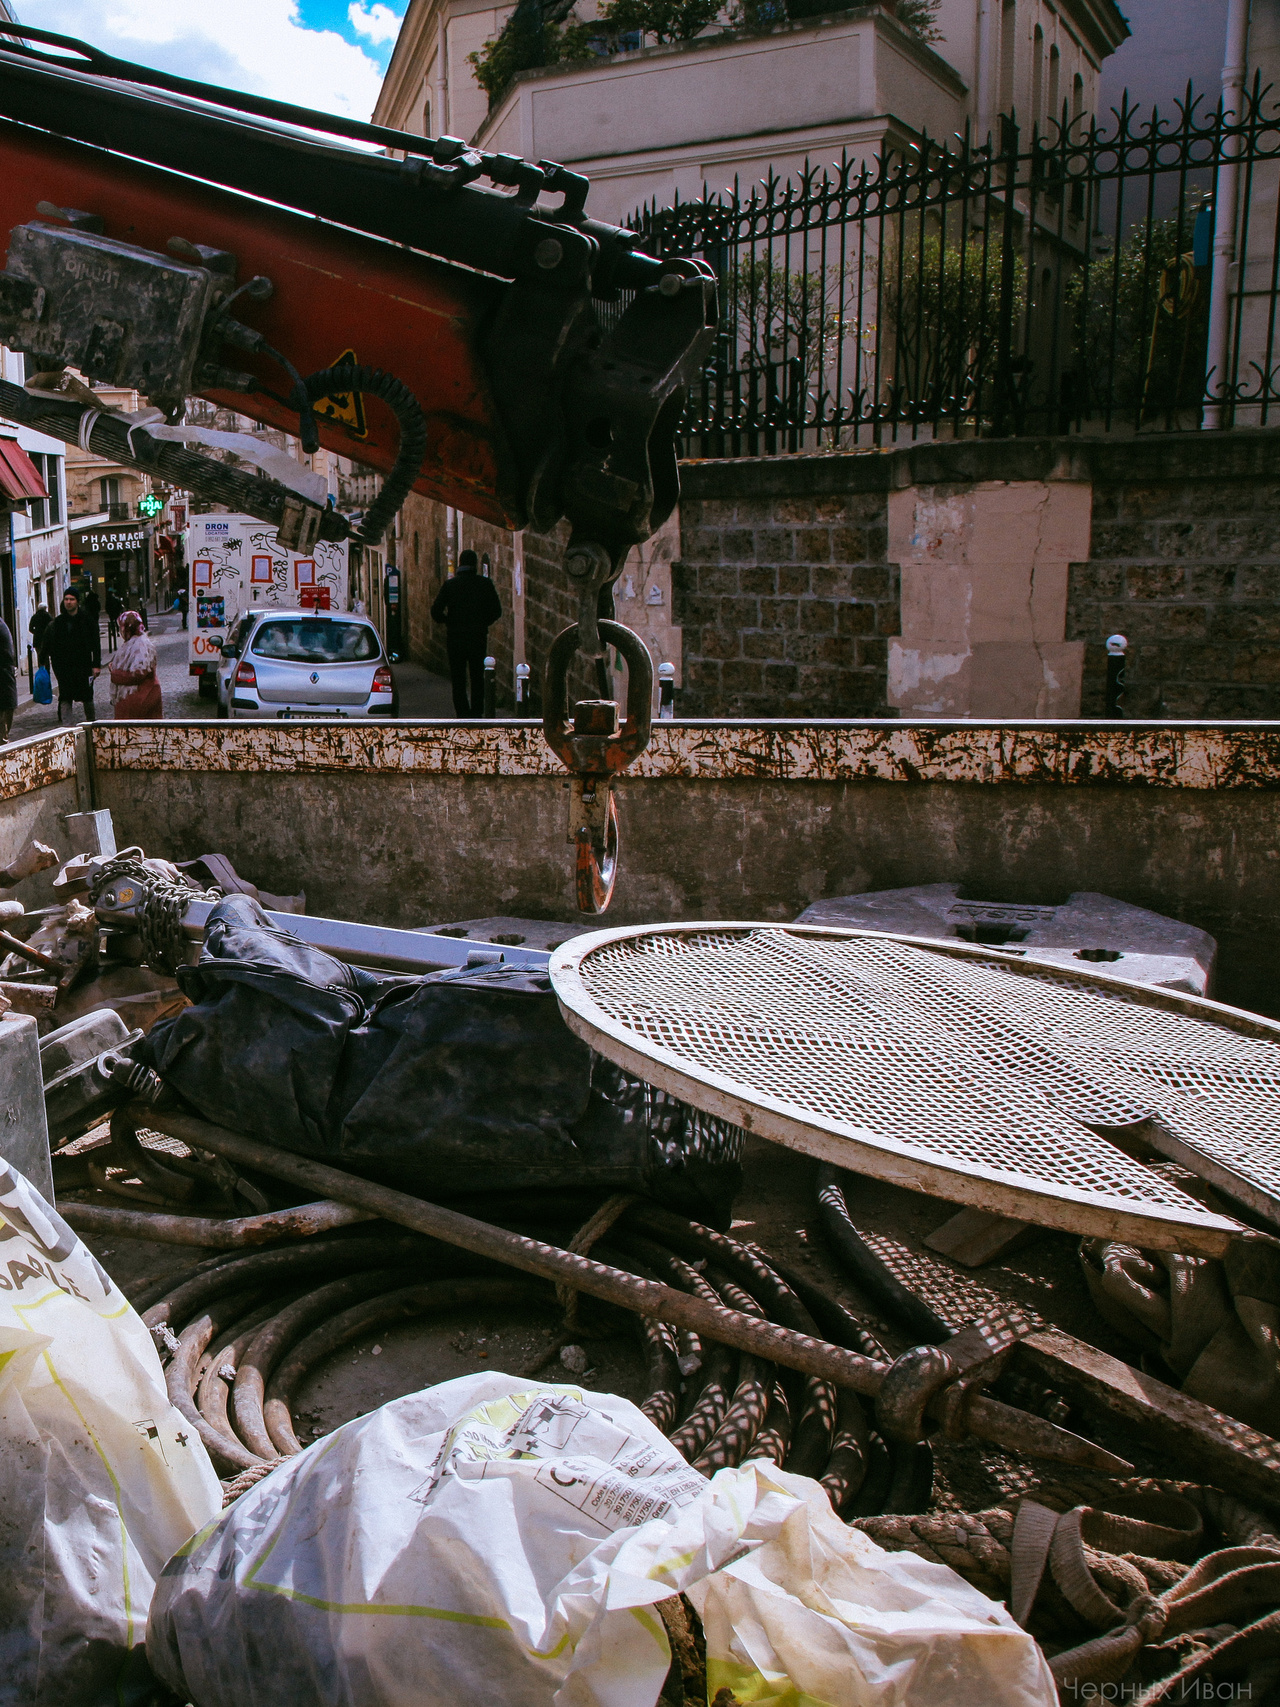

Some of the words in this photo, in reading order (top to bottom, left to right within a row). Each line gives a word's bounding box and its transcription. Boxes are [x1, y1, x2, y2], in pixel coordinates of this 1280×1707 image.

[81, 530, 145, 544] PHARMACIE
[92, 540, 142, 552] D'ORSEL
[386, 567, 393, 576] P
[590, 1484, 608, 1508] Code
[612, 1486, 635, 1517] 3917501
